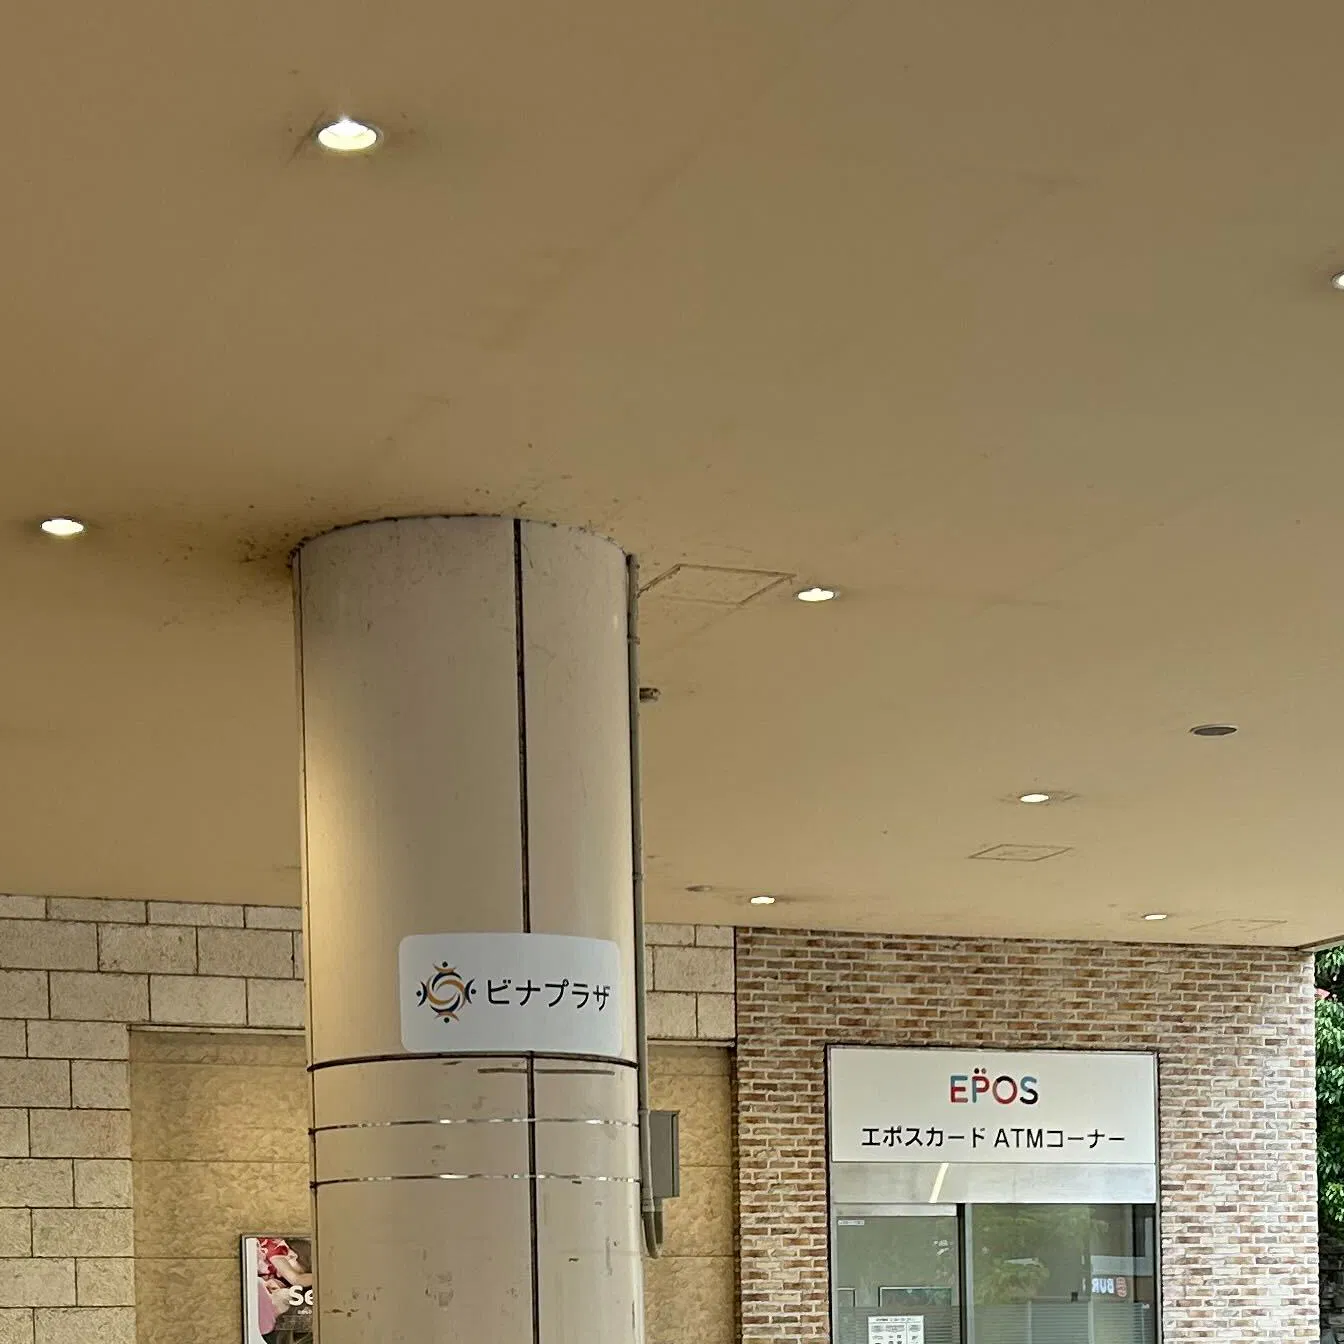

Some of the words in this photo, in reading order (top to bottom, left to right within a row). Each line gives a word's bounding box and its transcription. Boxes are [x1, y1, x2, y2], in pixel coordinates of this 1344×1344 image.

[487, 979, 610, 1011] ビナプラザ
[950, 1068, 1039, 1105] EPOS
[861, 1126, 986, 1148] エポスカード
[994, 1127, 1125, 1149] ATMコーナー
